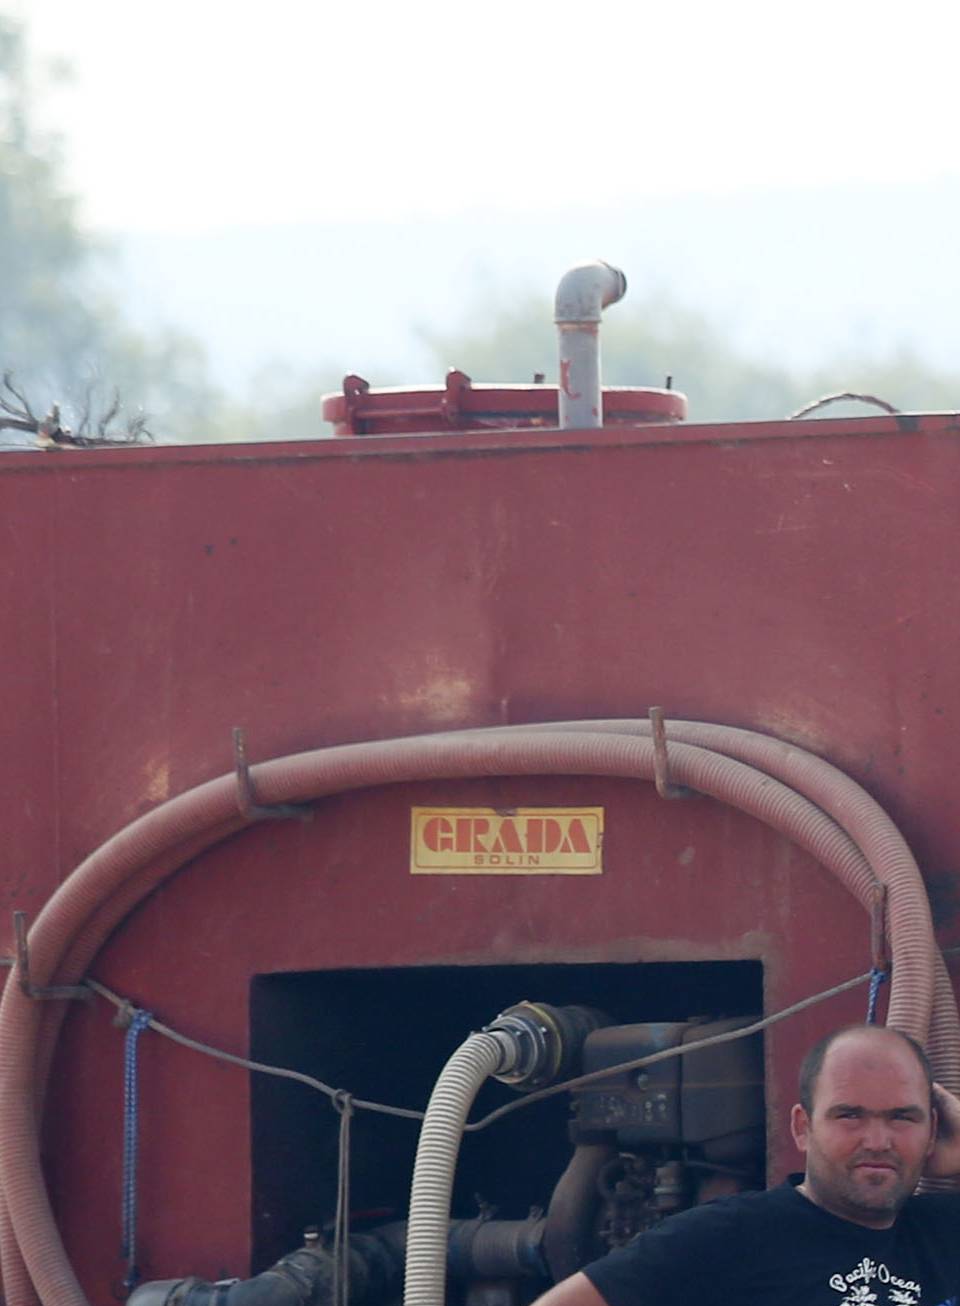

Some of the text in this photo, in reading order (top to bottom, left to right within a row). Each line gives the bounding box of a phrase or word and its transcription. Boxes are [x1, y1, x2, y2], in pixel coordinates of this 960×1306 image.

[422, 817, 592, 854] GRADA
[473, 854, 541, 866] SOLIN
[877, 1263, 922, 1298] Ocean
